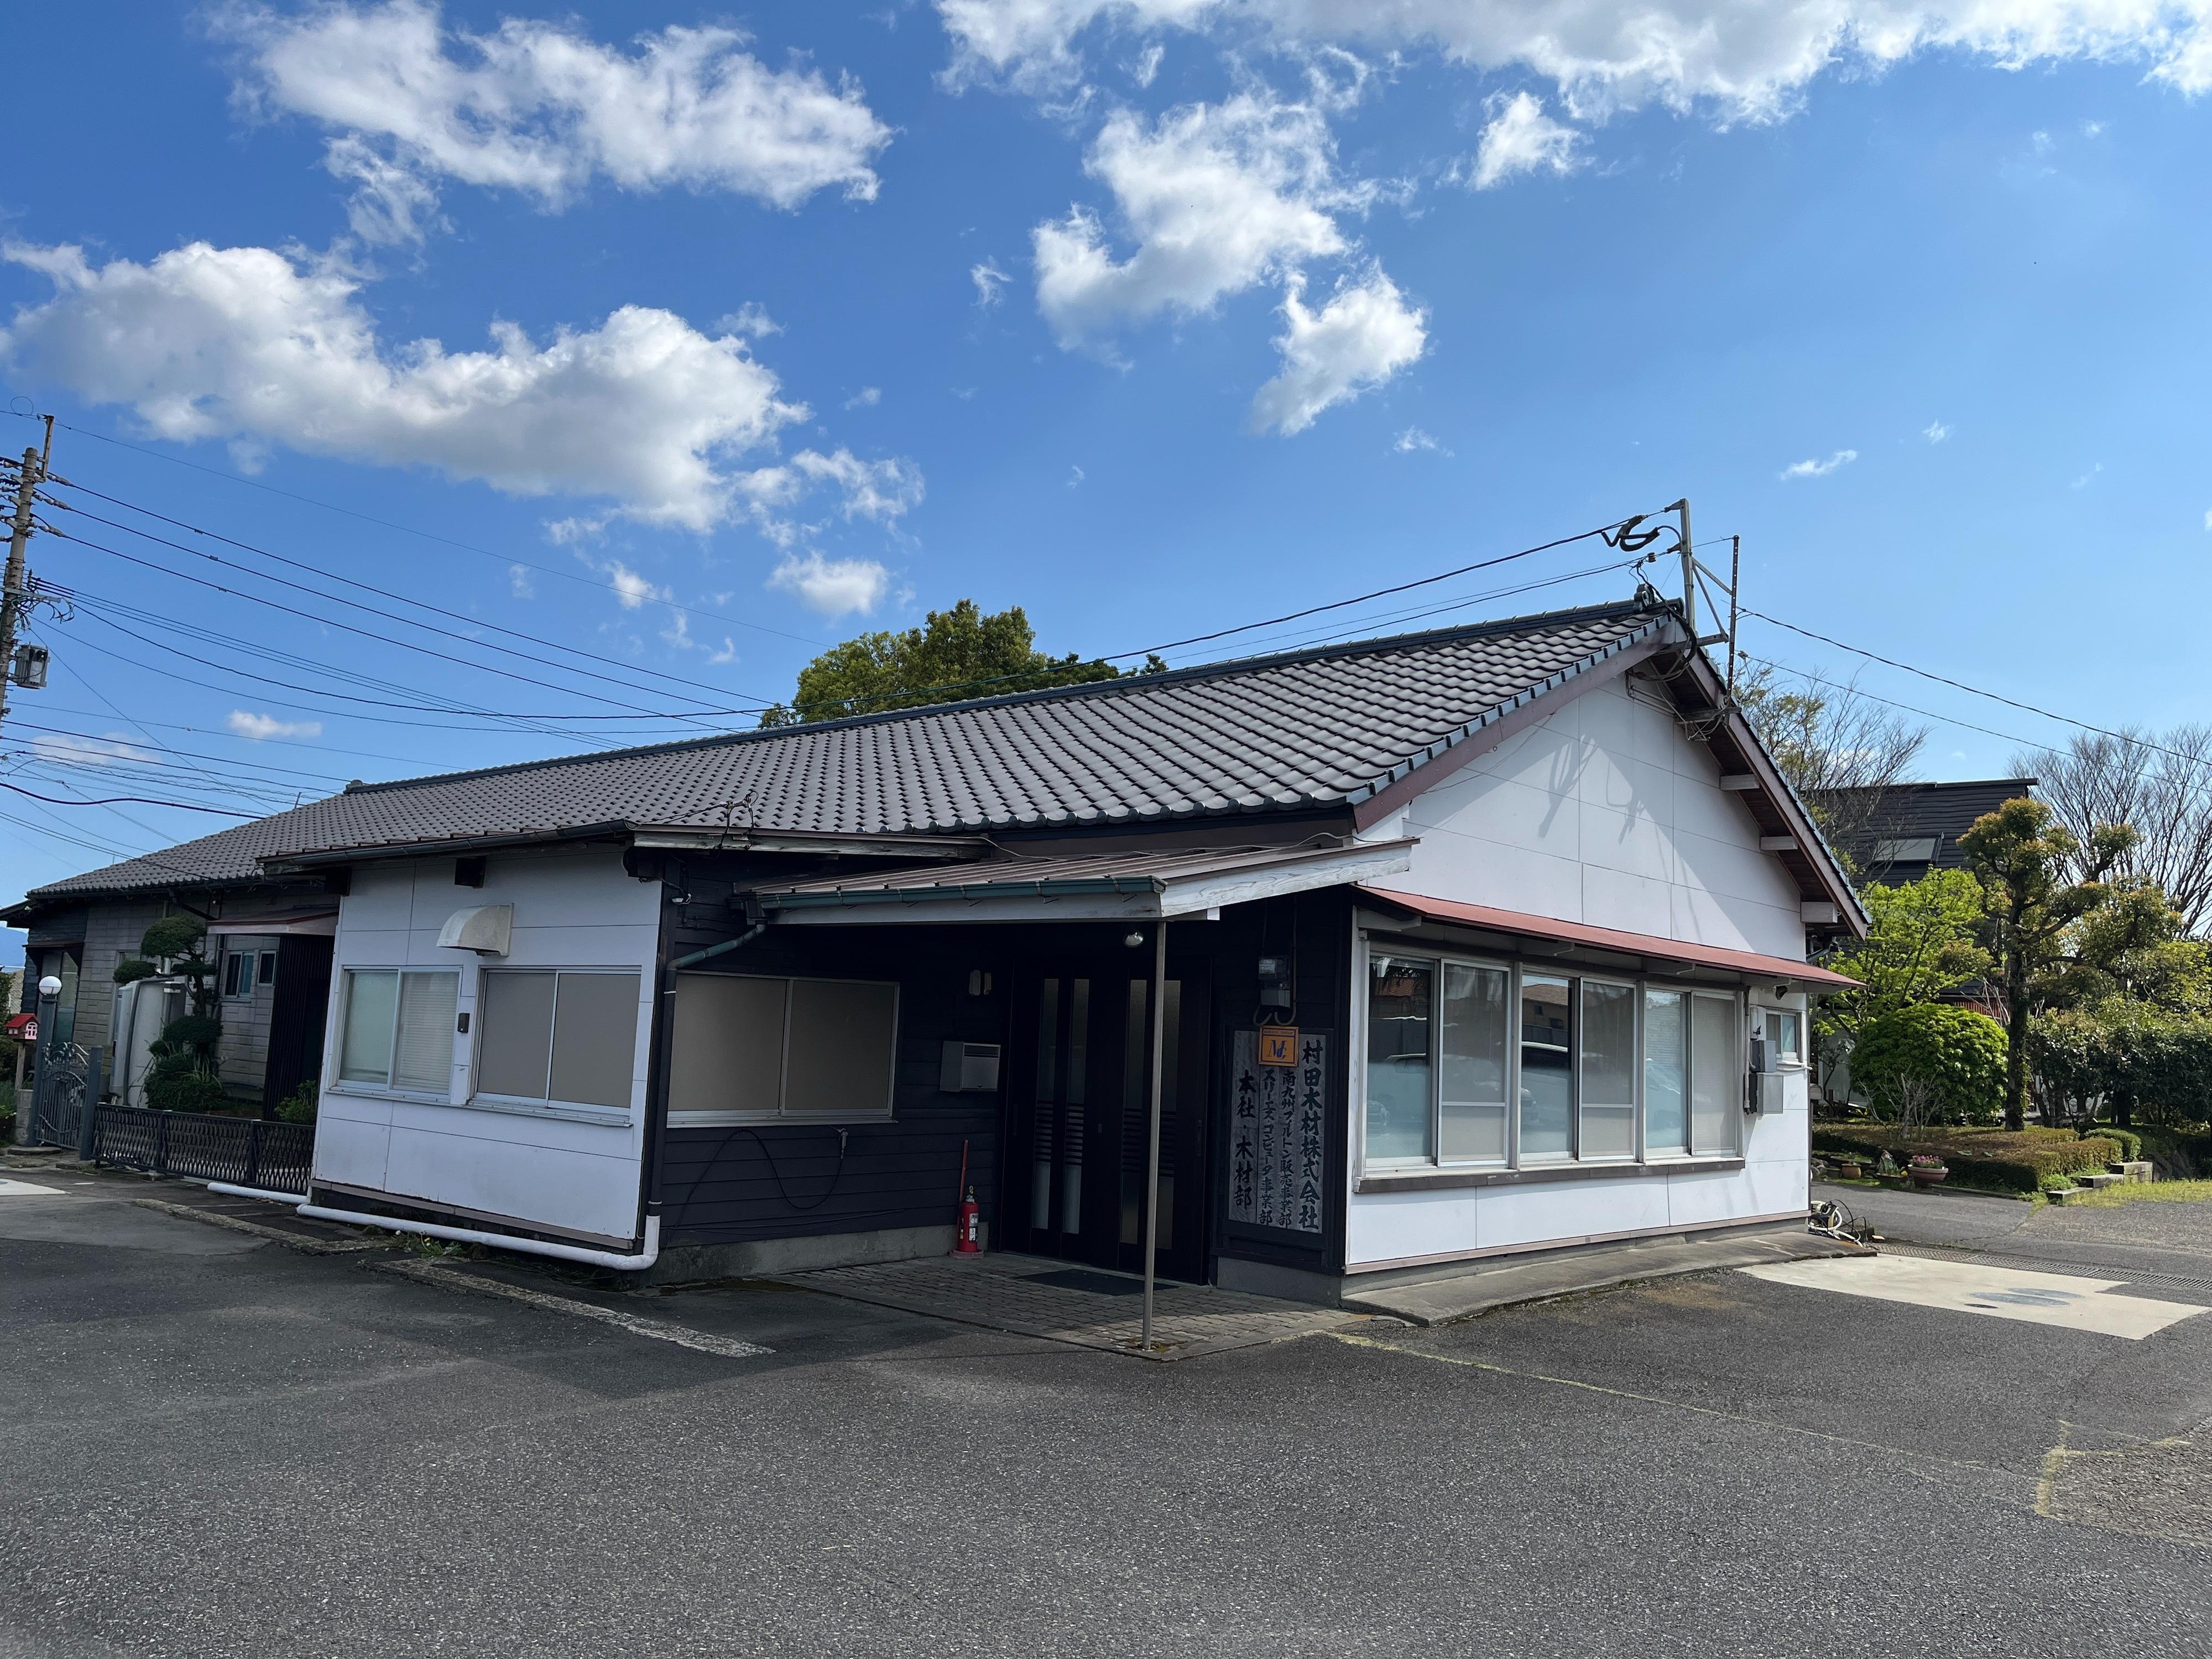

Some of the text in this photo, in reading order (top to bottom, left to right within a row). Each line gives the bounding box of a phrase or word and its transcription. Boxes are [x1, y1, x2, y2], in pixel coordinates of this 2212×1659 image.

[1233, 1069, 1257, 1211] 本社・木材部
[1298, 1039, 1323, 1230] 村田木材株式会社
